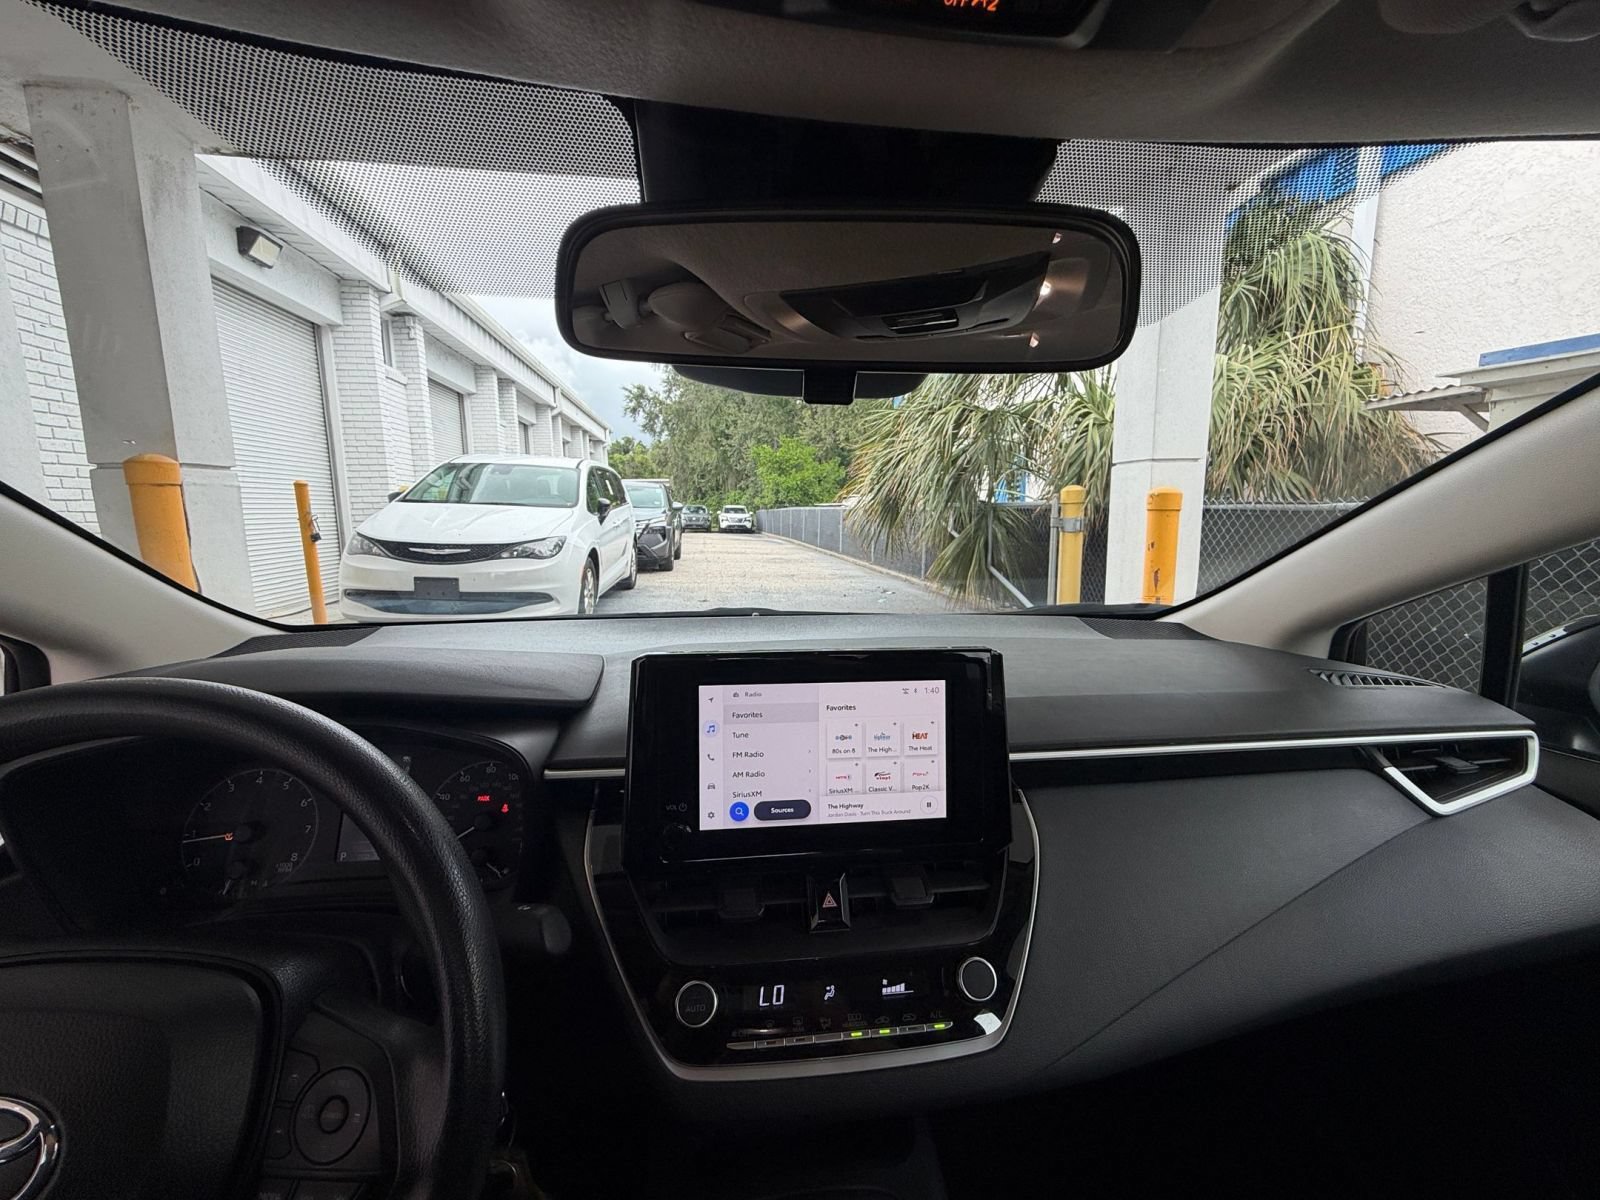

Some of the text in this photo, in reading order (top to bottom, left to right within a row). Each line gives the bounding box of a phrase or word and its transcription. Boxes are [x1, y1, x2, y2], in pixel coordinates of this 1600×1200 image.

[826, 704, 857, 712] Favorites
[732, 711, 763, 719] Favorites
[912, 732, 929, 740] HEAT
[255, 776, 263, 784] 4
[228, 783, 235, 793] 3
[282, 781, 289, 790] 5
[203, 802, 212, 811] 2
[300, 798, 308, 807] 6
[305, 825, 312, 833] 7
[290, 852, 298, 862] 8
[340, 852, 347, 861] P
[193, 857, 201, 866] 0
[759, 984, 785, 1008] LO
[685, 1004, 706, 1013] AUTO
